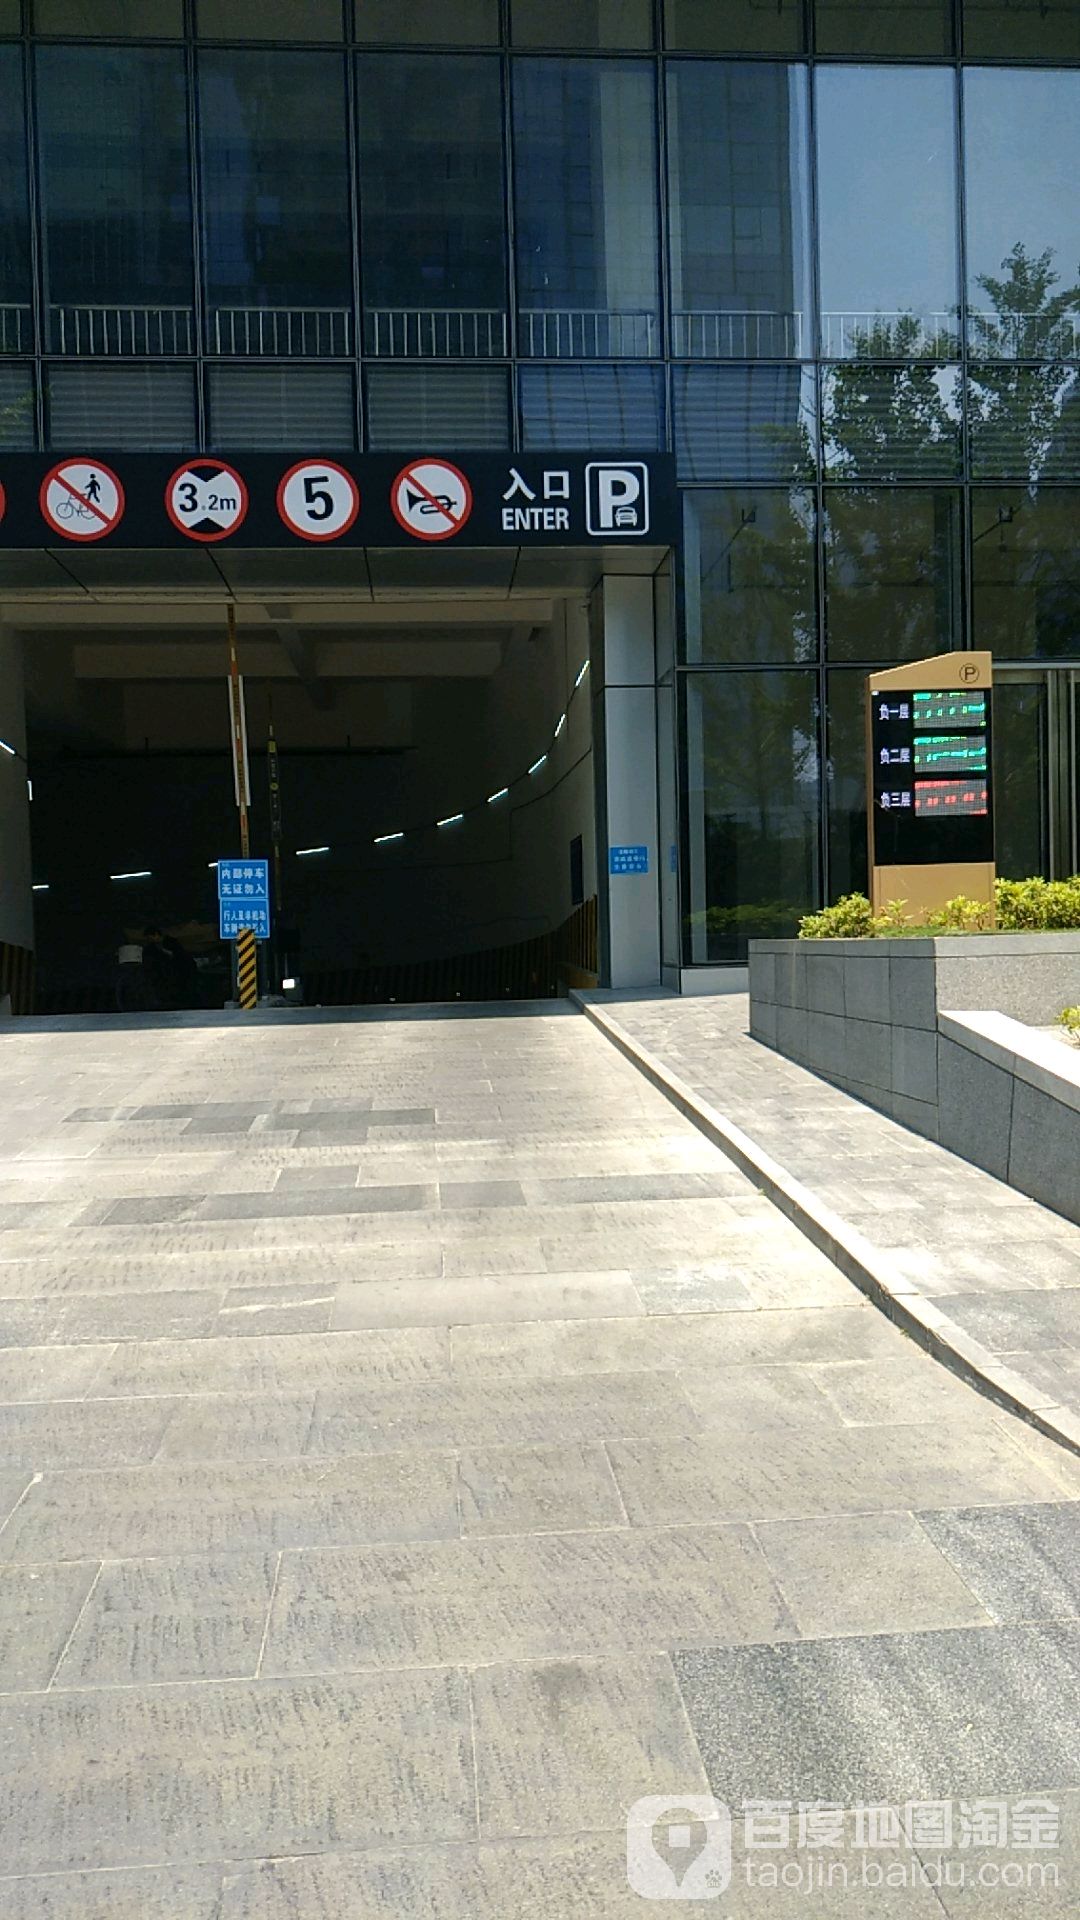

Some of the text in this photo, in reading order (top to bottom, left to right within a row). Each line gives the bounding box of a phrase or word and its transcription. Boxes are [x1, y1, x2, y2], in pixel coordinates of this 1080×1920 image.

[502, 468, 570, 501] 入口
[178, 483, 237, 513] 3.2m
[303, 475, 335, 521] 5
[599, 469, 641, 529] P
[501, 507, 570, 531] ENTER
[878, 702, 910, 721] 负一层
[880, 747, 911, 765] 负二层
[880, 791, 911, 809] 负三层
[221, 867, 265, 879] 内部停车
[221, 883, 266, 895] 无证勿入
